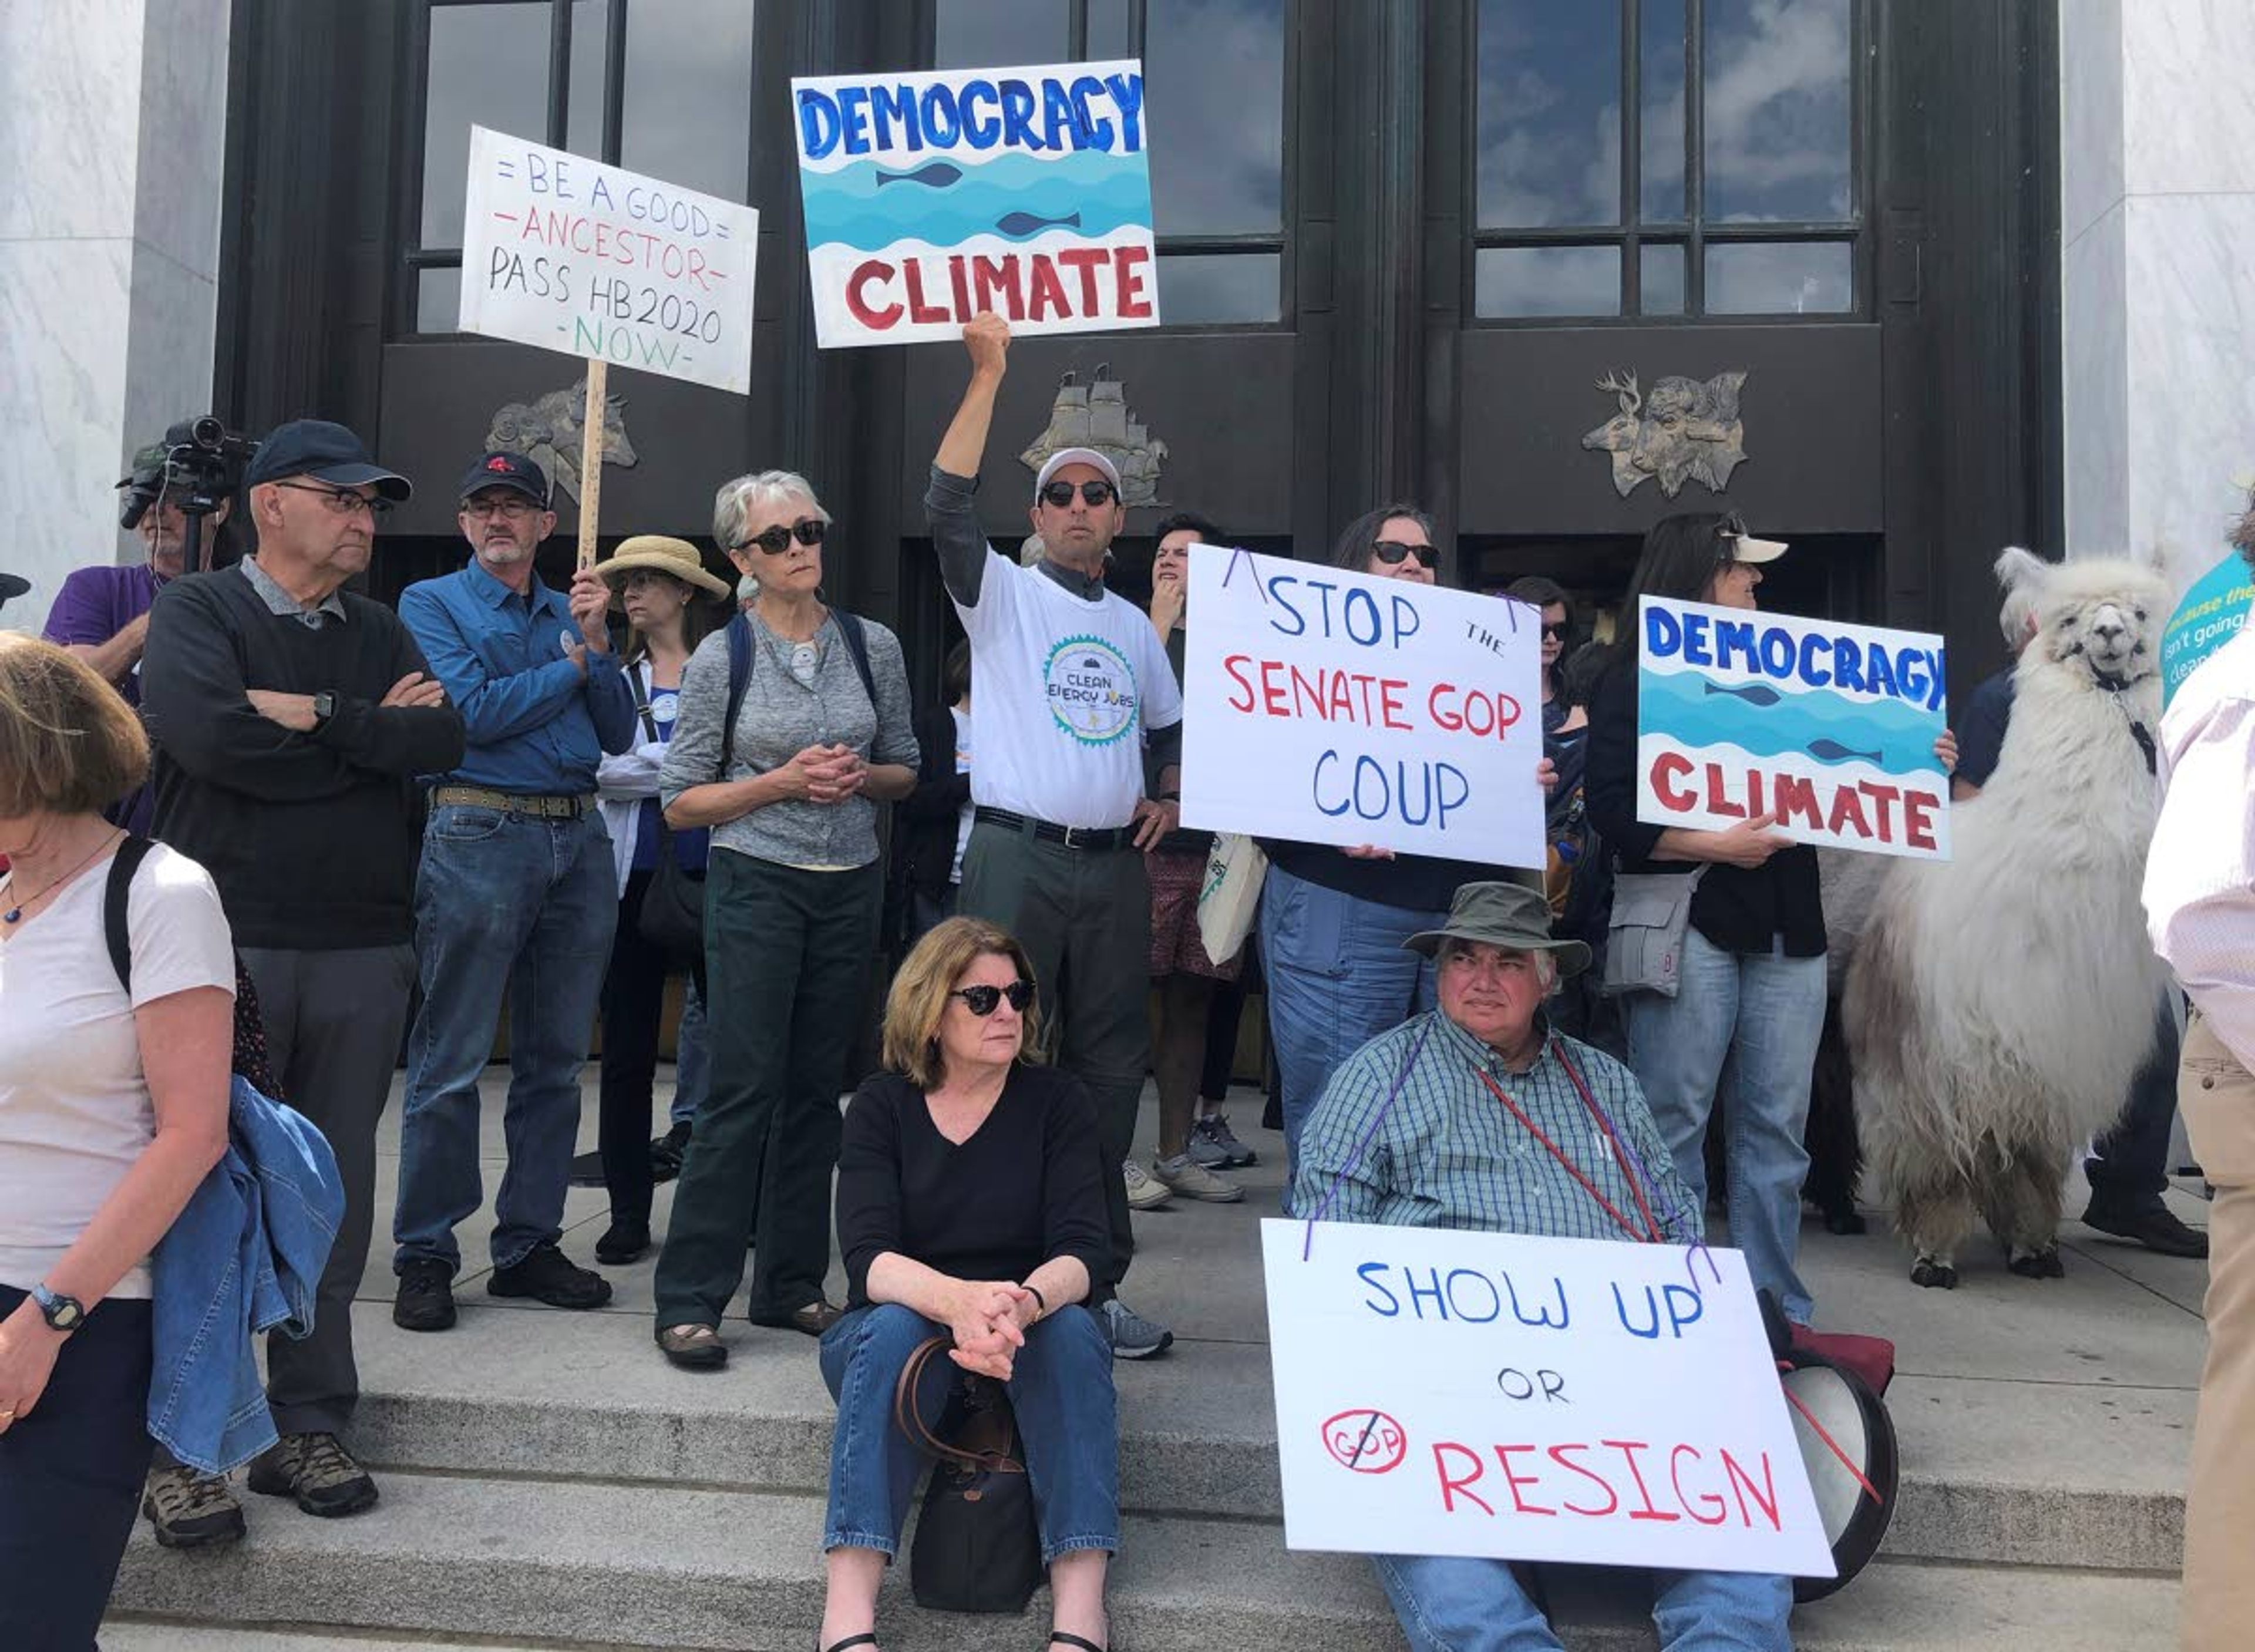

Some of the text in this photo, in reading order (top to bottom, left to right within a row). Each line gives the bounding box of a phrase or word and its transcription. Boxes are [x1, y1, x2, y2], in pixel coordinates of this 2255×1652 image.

[796, 73, 1143, 160] DEMOCRACY
[591, 176, 614, 211] A
[490, 246, 721, 344] PASS HB2020
[846, 246, 1152, 330] CLIMATE
[1268, 576, 1506, 658] STOP THE
[2194, 613, 2245, 648] going
[1067, 674, 1112, 689] CLEAN
[1224, 655, 1521, 741] SENATE GOP
[1313, 749, 1469, 829] COUP
[1650, 752, 1940, 850] CLIMATE
[1356, 1262, 1704, 1339] SHOW UP
[1497, 1368, 1574, 1405] OR
[1335, 1428, 1782, 1532] GOP RESIGN
